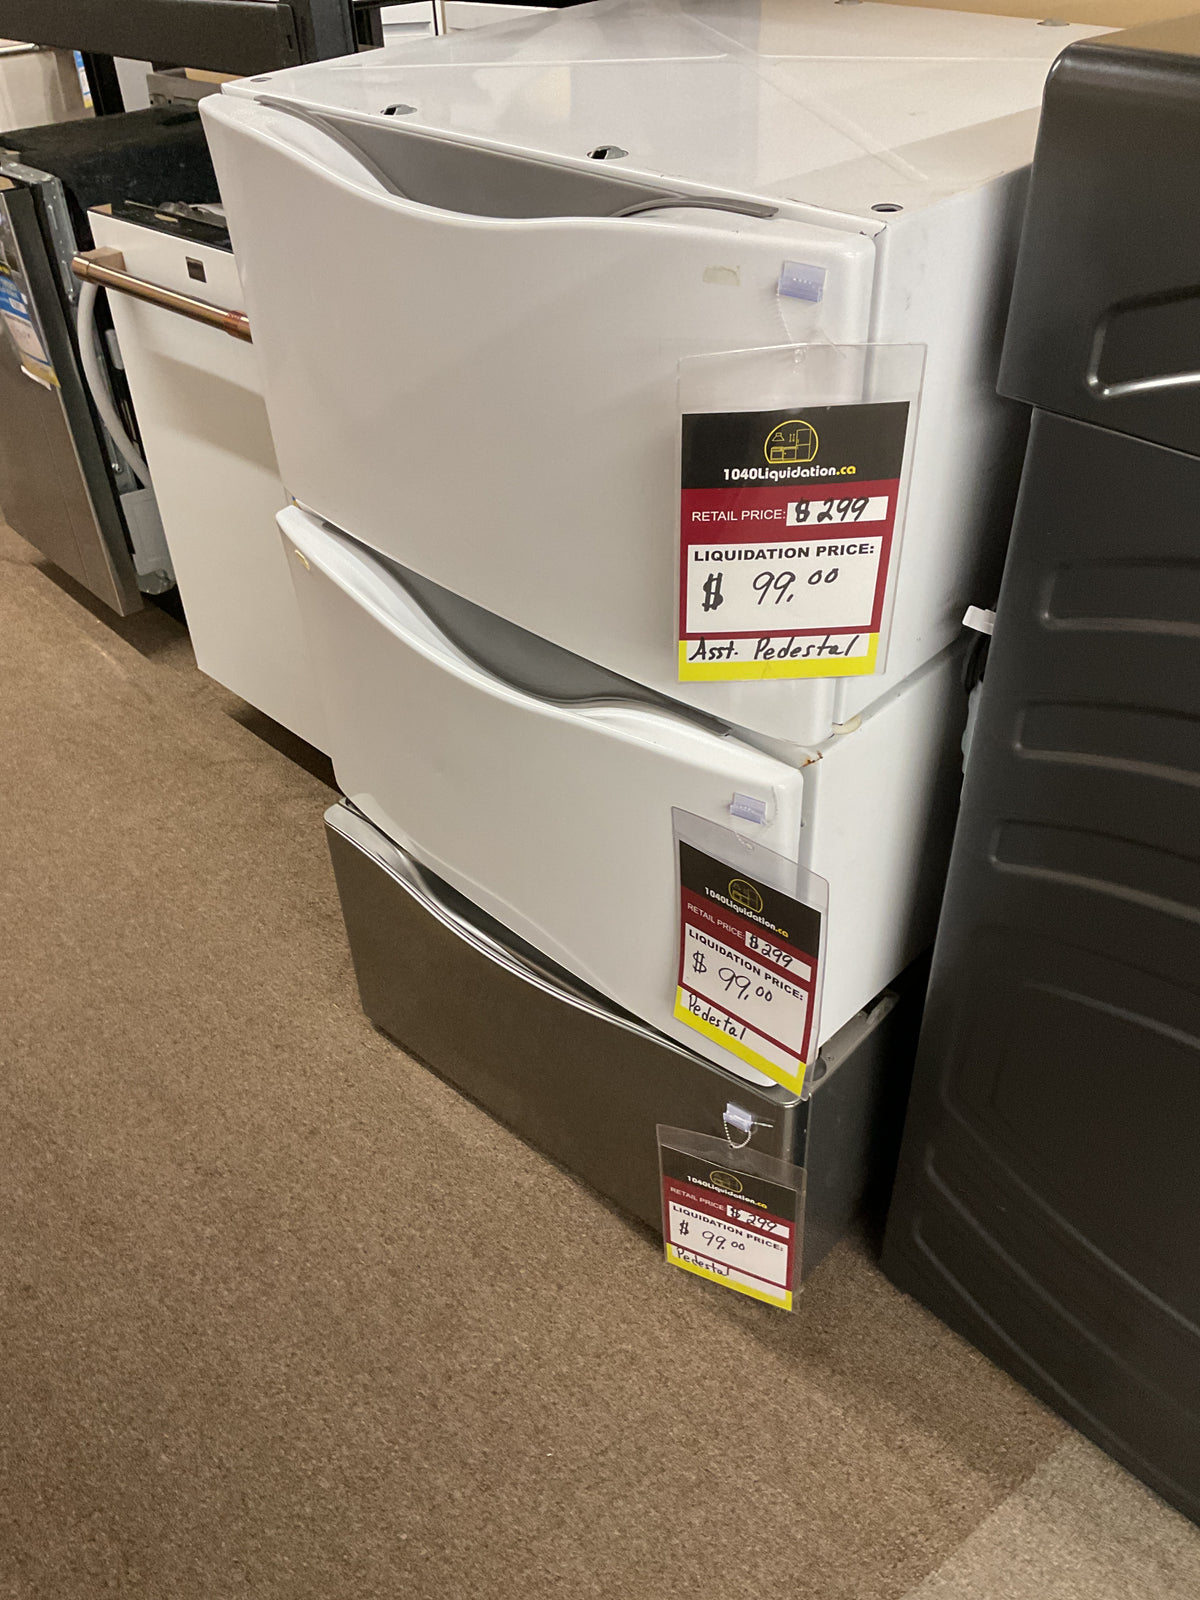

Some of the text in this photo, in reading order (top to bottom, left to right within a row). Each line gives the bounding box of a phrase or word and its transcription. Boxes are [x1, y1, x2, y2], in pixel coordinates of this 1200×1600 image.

[723, 464, 856, 482] 1040Liquidation.ca
[691, 510, 737, 522] RETAIL
[741, 509, 786, 521] PRICE:
[694, 543, 875, 562] LIQUIDATION PRICE:
[753, 634, 860, 660] Pedestal
[687, 902, 716, 924] RETAIL
[716, 919, 745, 939] PRICE:
[704, 886, 790, 938] 1040Liquidation.ca
[689, 928, 804, 1001] LIQUIDATION PRICE:
[688, 993, 747, 1041] Pedestal
[670, 1187, 698, 1202] RETAIL
[686, 1175, 768, 1209] 1040Liquidation.ca
[673, 1205, 784, 1251] LIQUIDATION PRICE:
[676, 1247, 730, 1277] Pedestal
